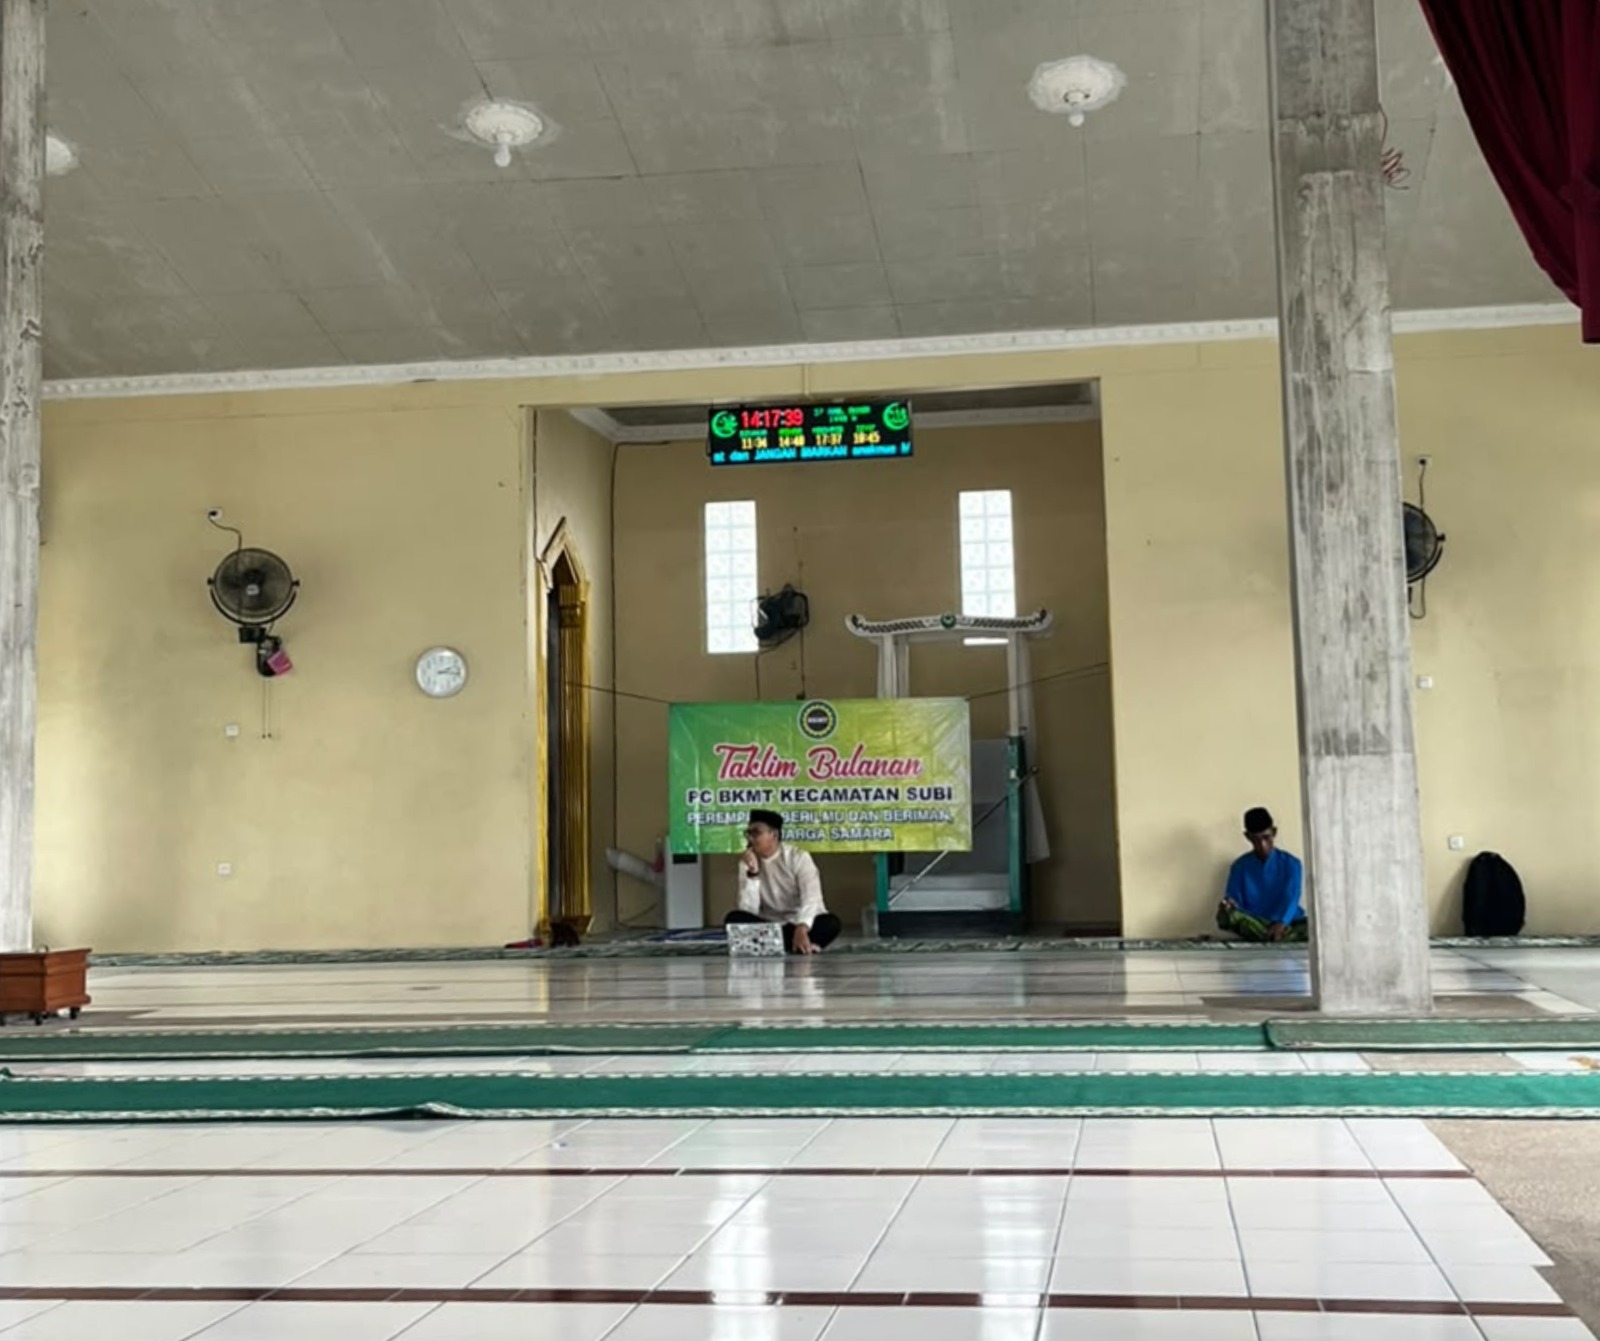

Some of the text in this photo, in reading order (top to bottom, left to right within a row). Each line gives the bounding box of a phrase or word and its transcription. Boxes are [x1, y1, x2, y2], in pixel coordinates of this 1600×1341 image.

[741, 409, 804, 427] 14:17:39
[714, 743, 922, 780] Taklim Bulanan
[687, 786, 953, 804] PC BKMT KECAMATAN SUBI
[687, 811, 750, 825] PEREMP
[848, 811, 879, 823] DAN
[830, 827, 893, 840] SAMARA
